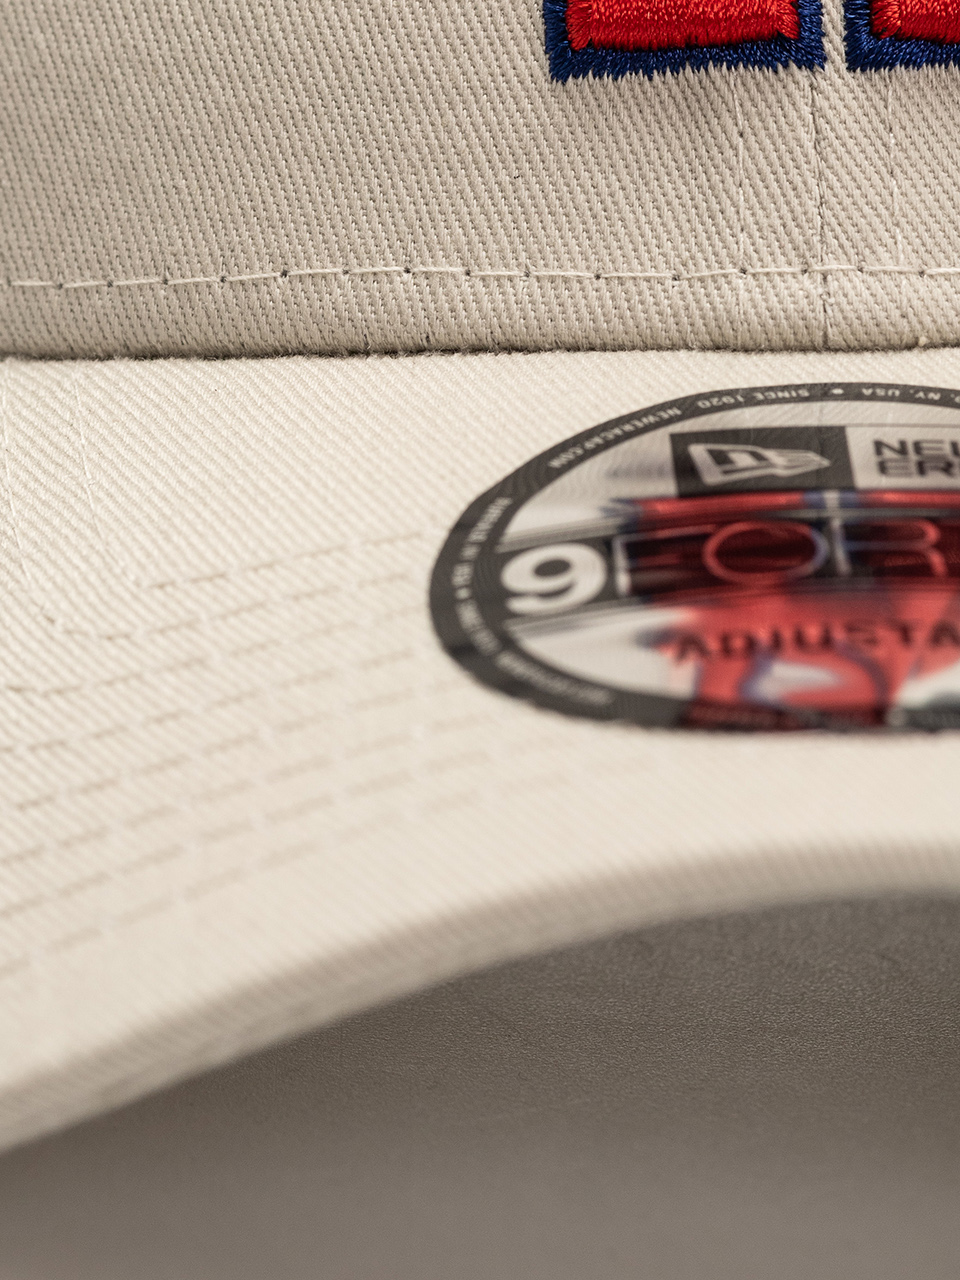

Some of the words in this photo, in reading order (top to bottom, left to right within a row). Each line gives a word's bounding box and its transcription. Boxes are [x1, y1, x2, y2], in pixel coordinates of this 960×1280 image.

[752, 388, 811, 401] SINCE
[861, 387, 900, 397] USA
[696, 393, 745, 409] 1920
[877, 458, 960, 478] ER
